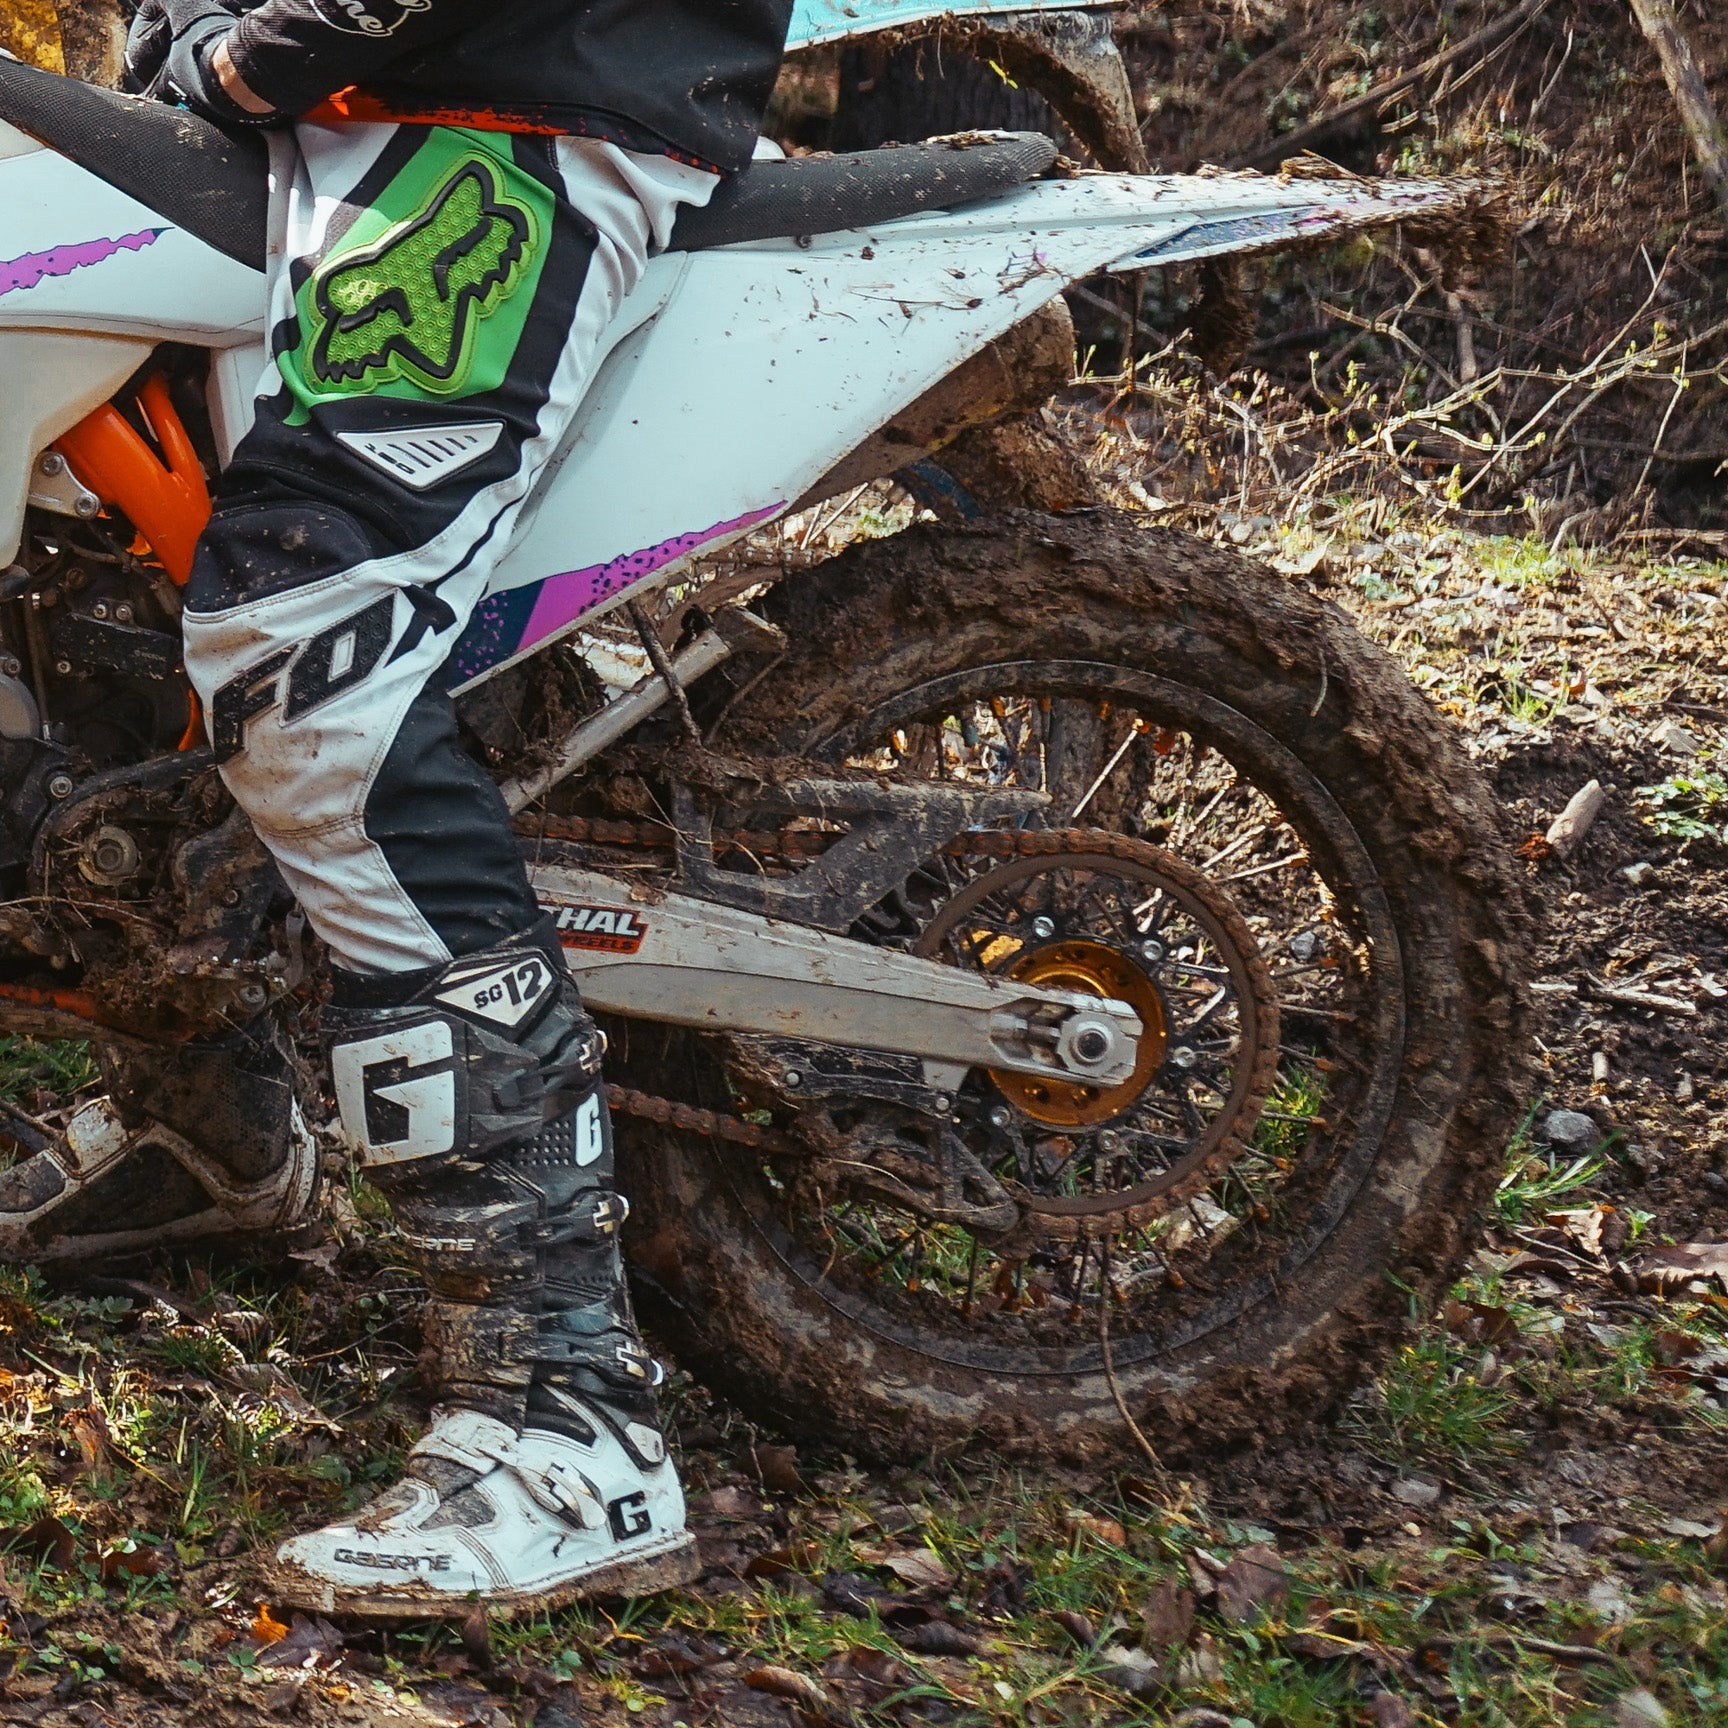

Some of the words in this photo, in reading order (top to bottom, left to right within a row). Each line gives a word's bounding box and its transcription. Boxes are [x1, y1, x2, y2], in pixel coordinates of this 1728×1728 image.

[332, 1020, 455, 1167] G
[574, 1092, 602, 1167] G
[607, 1489, 652, 1543] G
